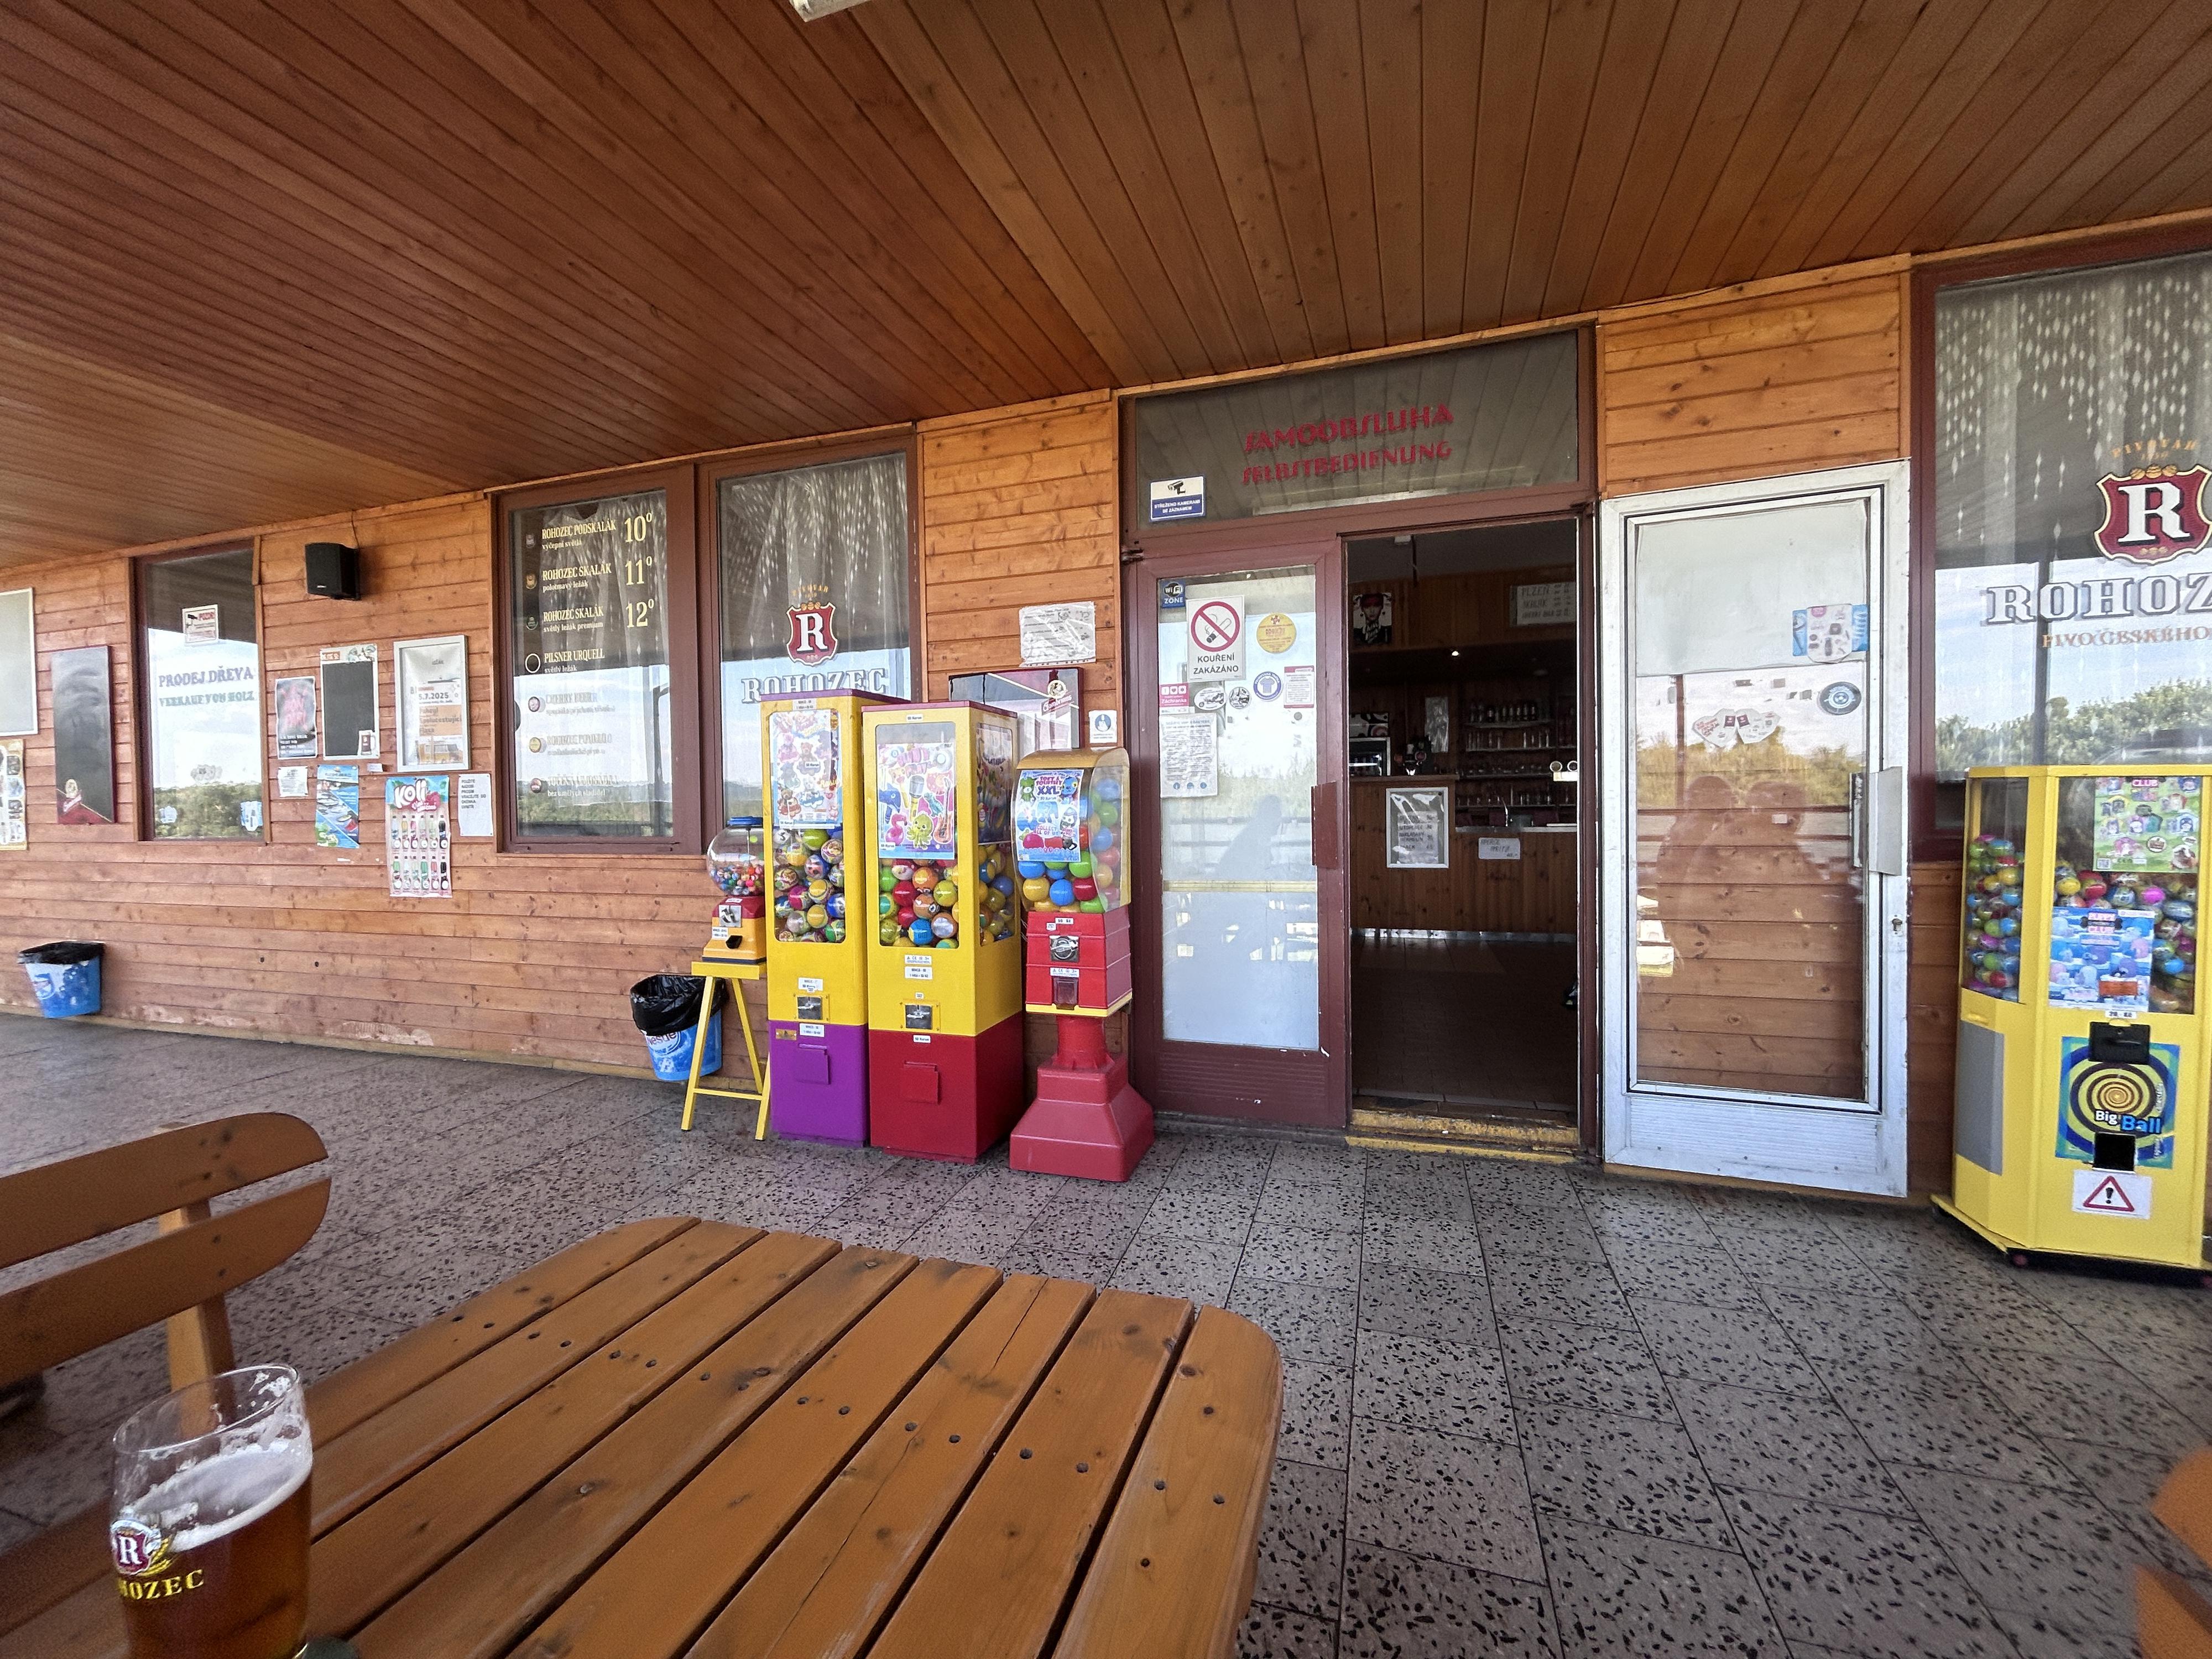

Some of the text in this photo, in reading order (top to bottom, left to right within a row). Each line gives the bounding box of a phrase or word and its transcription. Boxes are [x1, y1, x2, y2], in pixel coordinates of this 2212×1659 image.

[1244, 403, 1454, 453] SAMOOBSLUHA
[1243, 440, 1453, 486] SELBSTBEDIENUNG
[2117, 482, 2194, 546] R
[542, 525, 572, 539] ROHOZEC
[574, 518, 617, 536] PODSKALÁK
[542, 567, 577, 581] ROHOZEC
[579, 560, 612, 577] SKALÁK
[544, 609, 574, 622] ROHOZEC
[575, 604, 604, 618] SKALÁK
[577, 622, 604, 630] premium
[795, 613, 828, 653] R
[544, 648, 605, 663] PILSNER URQUELL
[1197, 653, 1234, 663] KOUŘENÍ
[159, 665, 254, 687] PRODEJ DŘEVA
[1193, 665, 1239, 674] ZAKÁZÁNO
[1037, 785, 1060, 795] XXL
[2095, 1109, 2162, 1134] Big Ball
[119, 1536, 143, 1565] R
